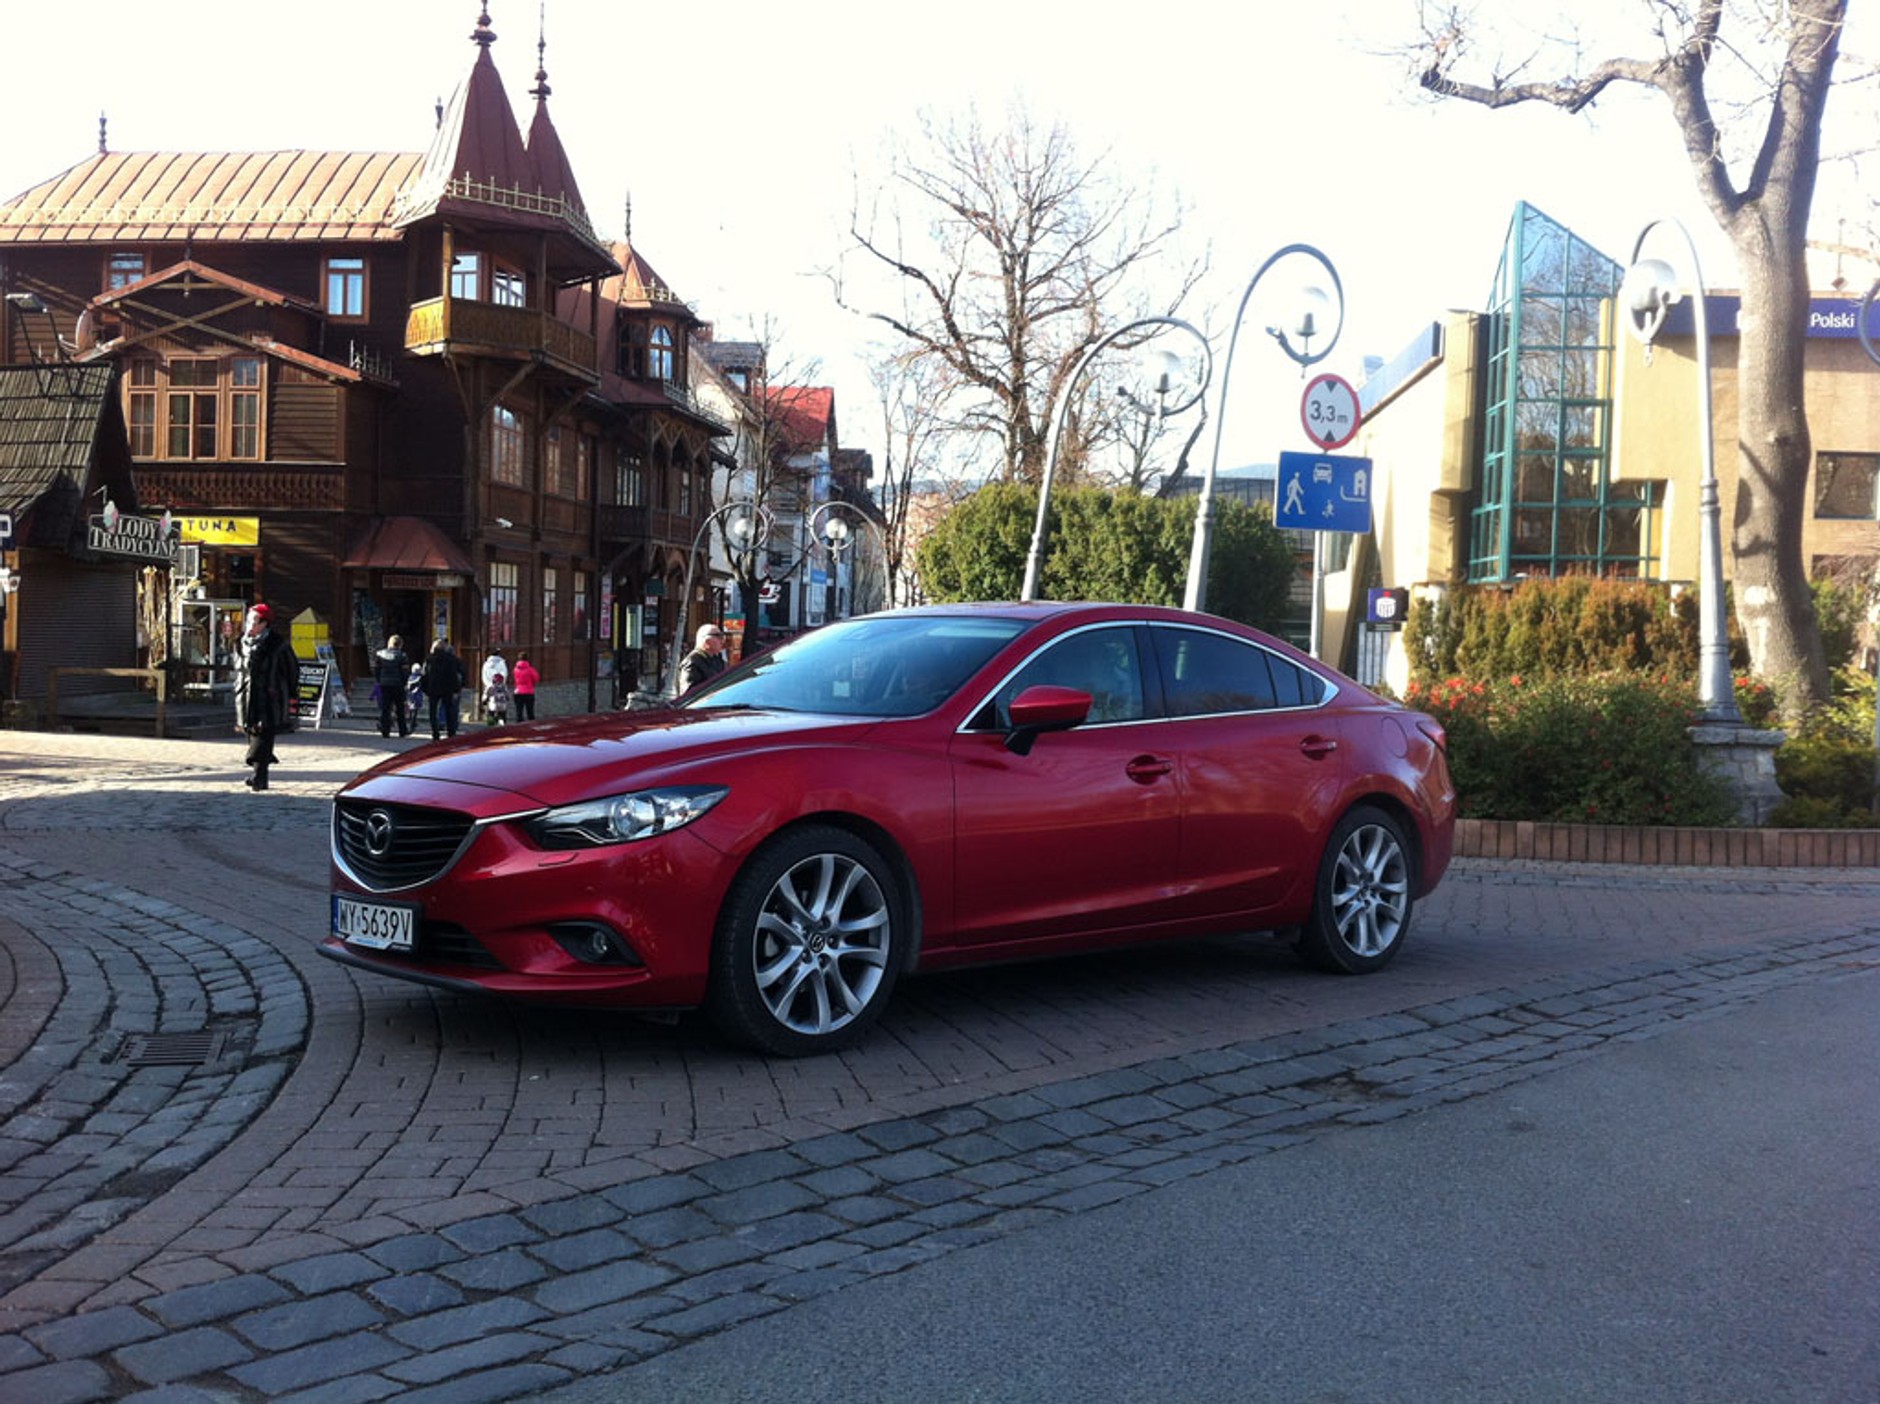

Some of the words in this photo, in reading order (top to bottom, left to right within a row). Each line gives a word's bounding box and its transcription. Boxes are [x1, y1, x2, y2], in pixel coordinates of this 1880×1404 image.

[1810, 312, 1855, 328] Polski
[91, 526, 178, 557] TRADYCYJNE
[118, 518, 158, 540] LODY
[361, 906, 411, 942] 5639V
